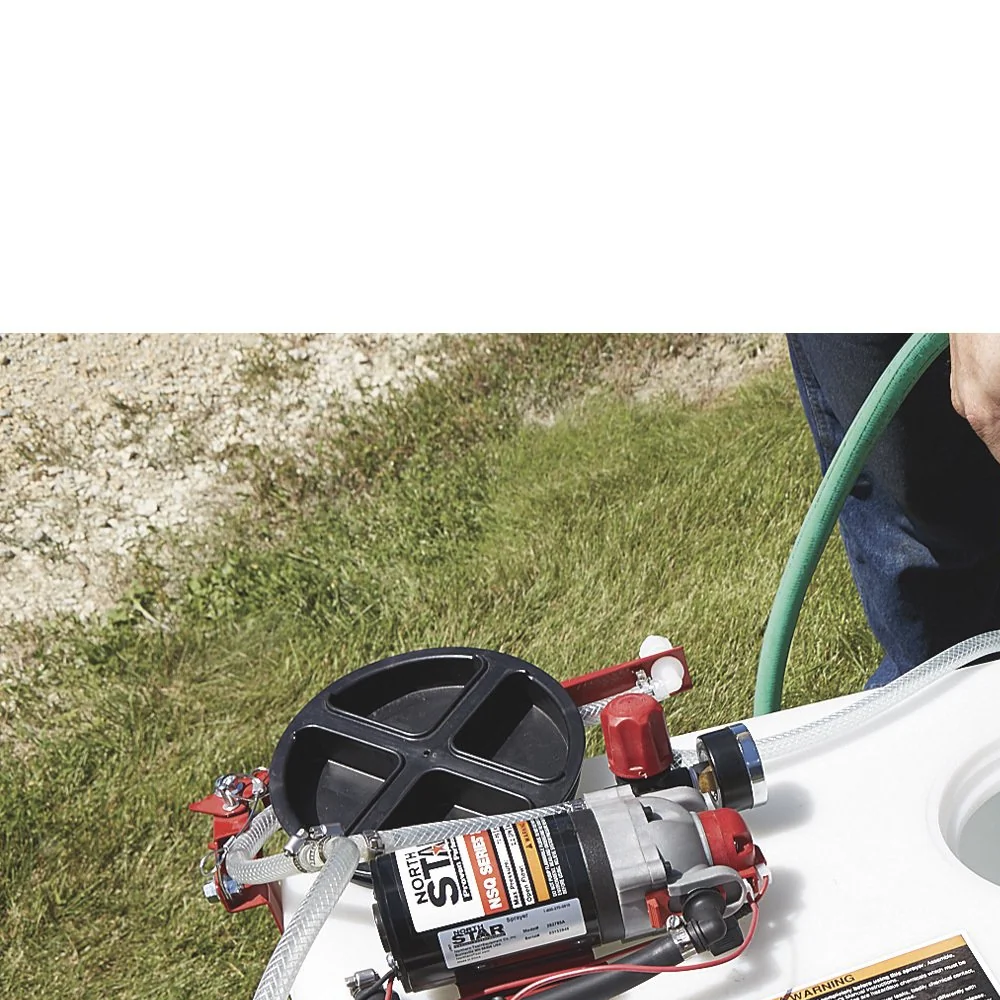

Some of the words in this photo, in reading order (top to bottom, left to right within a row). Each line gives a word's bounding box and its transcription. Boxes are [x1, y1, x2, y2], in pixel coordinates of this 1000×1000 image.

[471, 833, 494, 875] SERIES
[406, 851, 429, 904] NORTH
[417, 839, 461, 910] STA
[483, 876, 503, 909] NSQ
[512, 891, 520, 905] Max
[524, 884, 533, 902] Open
[450, 923, 505, 945] STAR
[452, 923, 484, 936] NORTH
[791, 974, 854, 1000] WARNING
